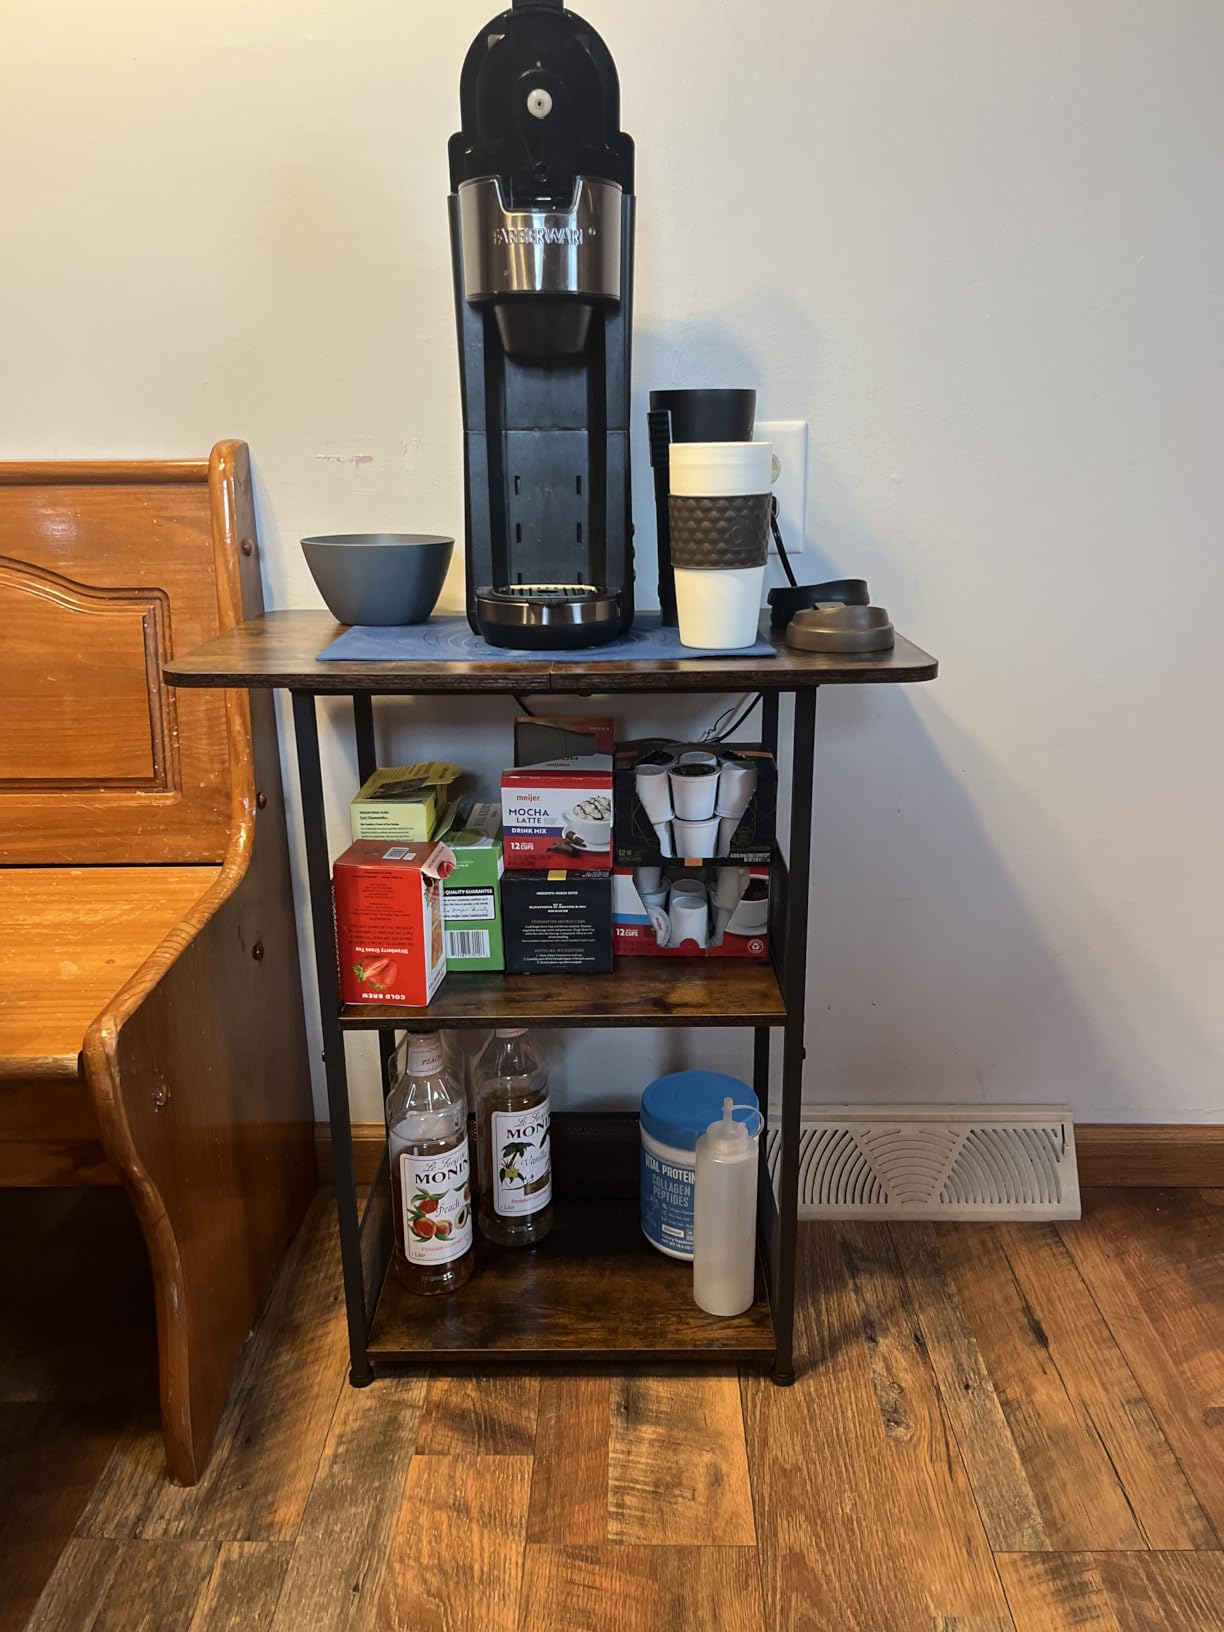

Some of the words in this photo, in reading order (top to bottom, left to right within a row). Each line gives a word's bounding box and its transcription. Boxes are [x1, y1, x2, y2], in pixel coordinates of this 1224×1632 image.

[516, 793, 541, 803] meijer
[508, 808, 550, 817] MOCHA
[510, 842, 520, 850] 12
[381, 946, 409, 955] Strawberry
[507, 1114, 551, 1140] MONI
[645, 1152, 660, 1172] VITAL
[662, 1165, 695, 1184] PROTEIN
[652, 1173, 691, 1197] COLLAGEN
[653, 1185, 689, 1207] PEPTIDES
[435, 1200, 460, 1217] Peach
